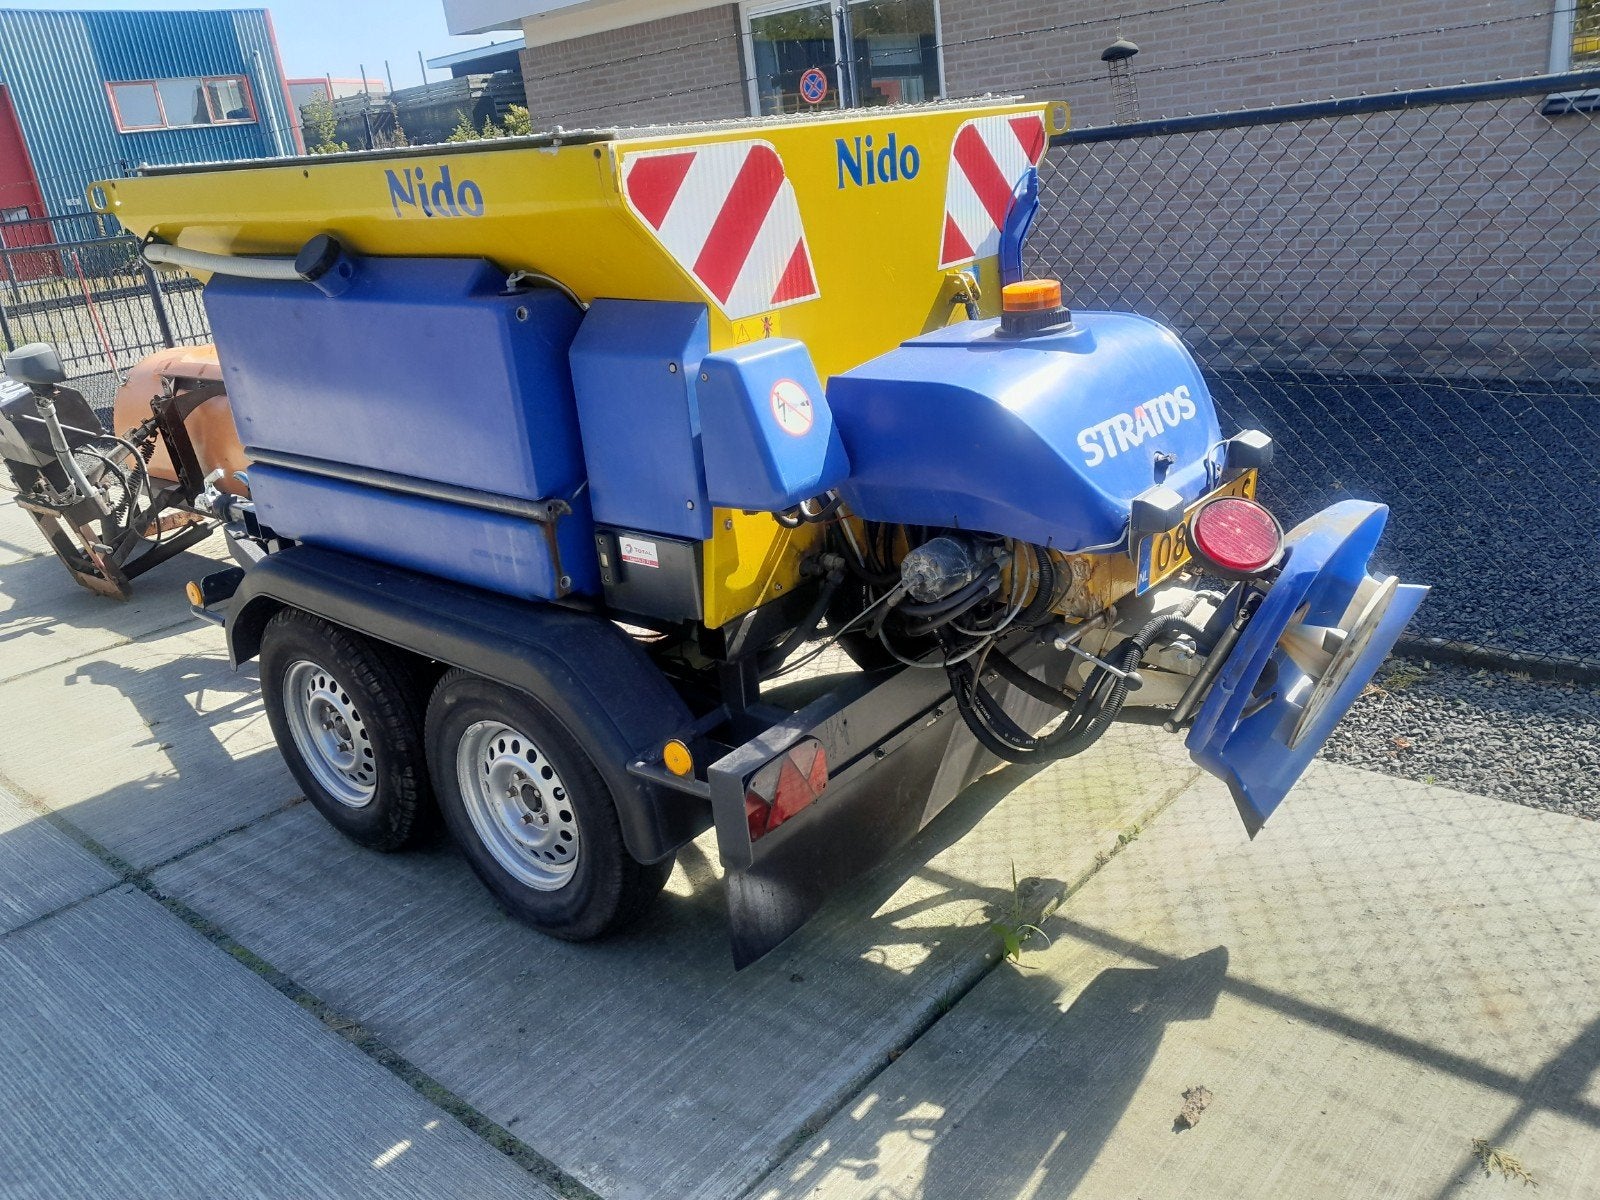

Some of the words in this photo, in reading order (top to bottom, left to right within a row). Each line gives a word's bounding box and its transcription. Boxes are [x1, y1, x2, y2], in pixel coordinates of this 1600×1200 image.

[835, 132, 920, 190] Nido
[384, 165, 485, 218] Nido
[1077, 385, 1196, 468] STRATOS
[634, 547, 652, 555] TOTAL
[1139, 573, 1149, 583] NL
